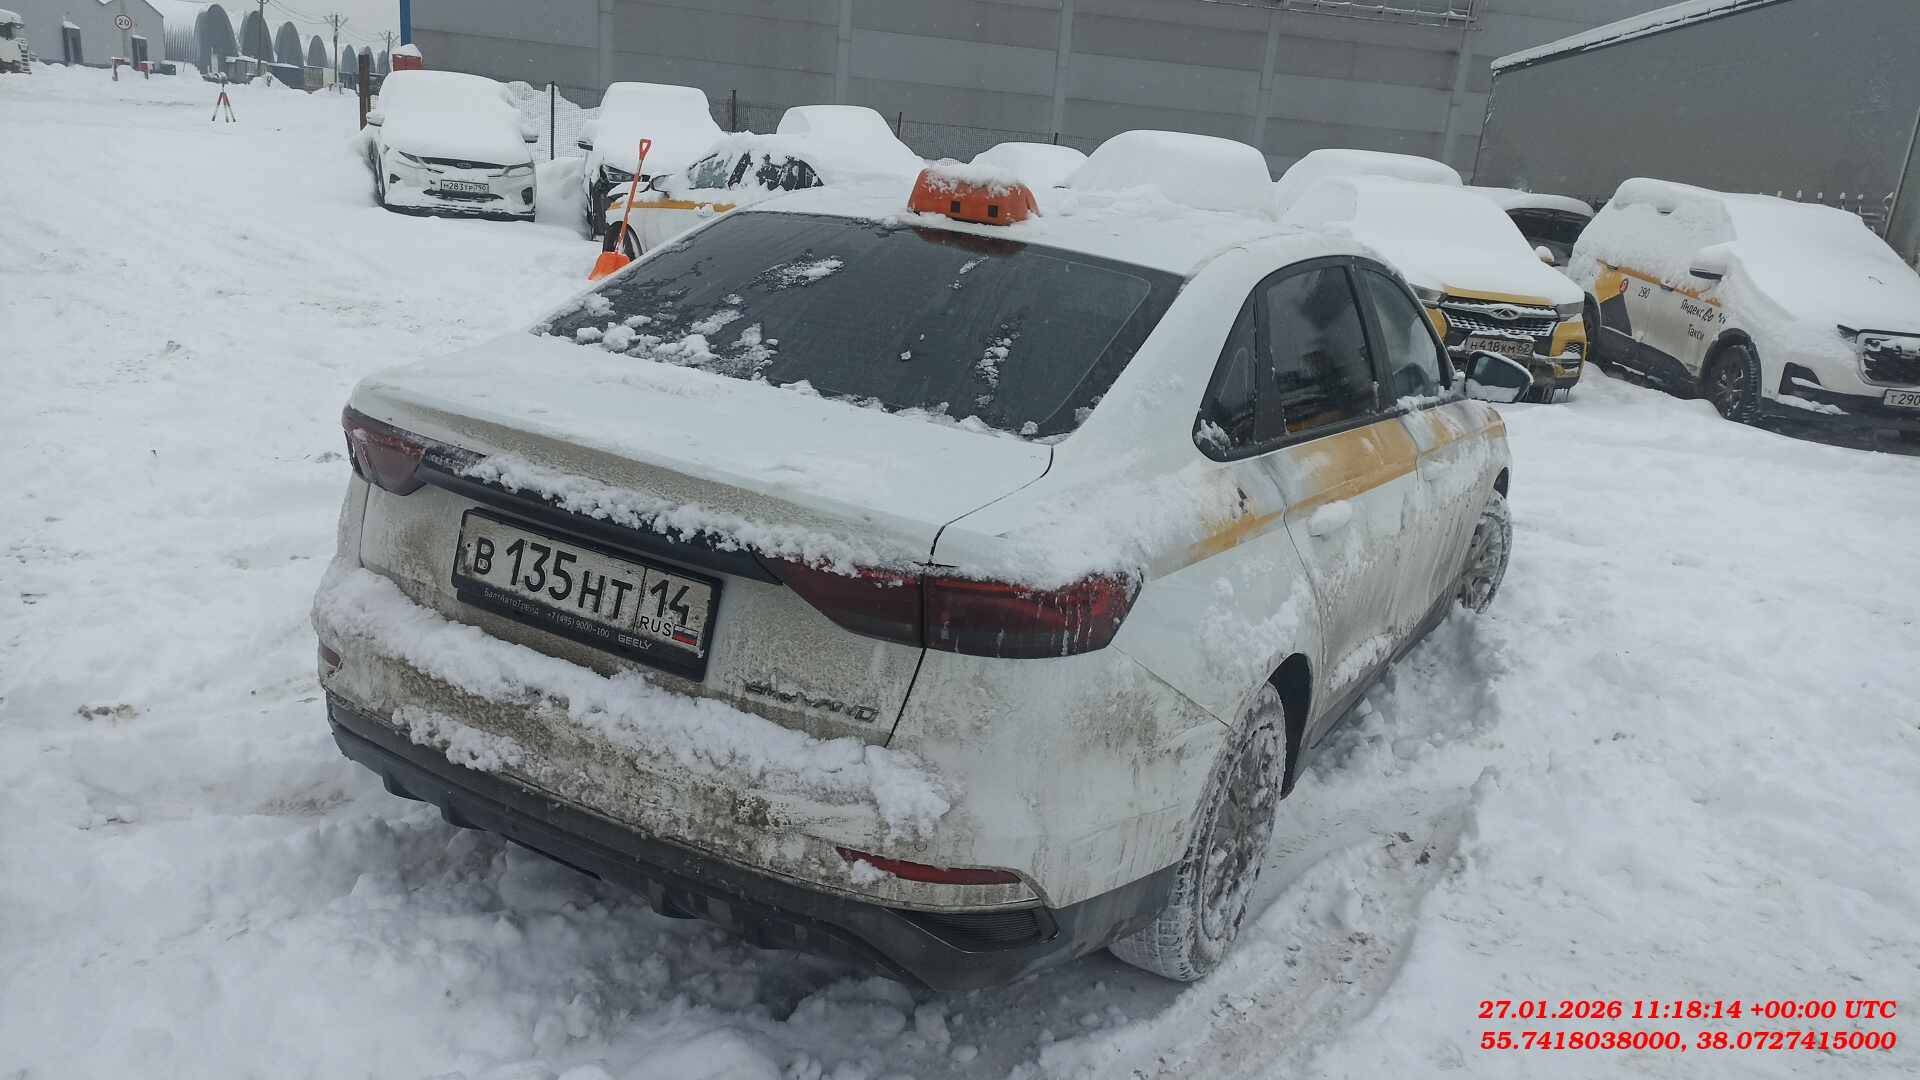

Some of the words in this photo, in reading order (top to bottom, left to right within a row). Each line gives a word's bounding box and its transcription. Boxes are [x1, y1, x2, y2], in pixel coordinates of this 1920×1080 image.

[1687, 323, 1705, 340] Такси
[650, 578, 689, 627] 14
[638, 615, 672, 637] RUS
[617, 633, 652, 650] GEELY
